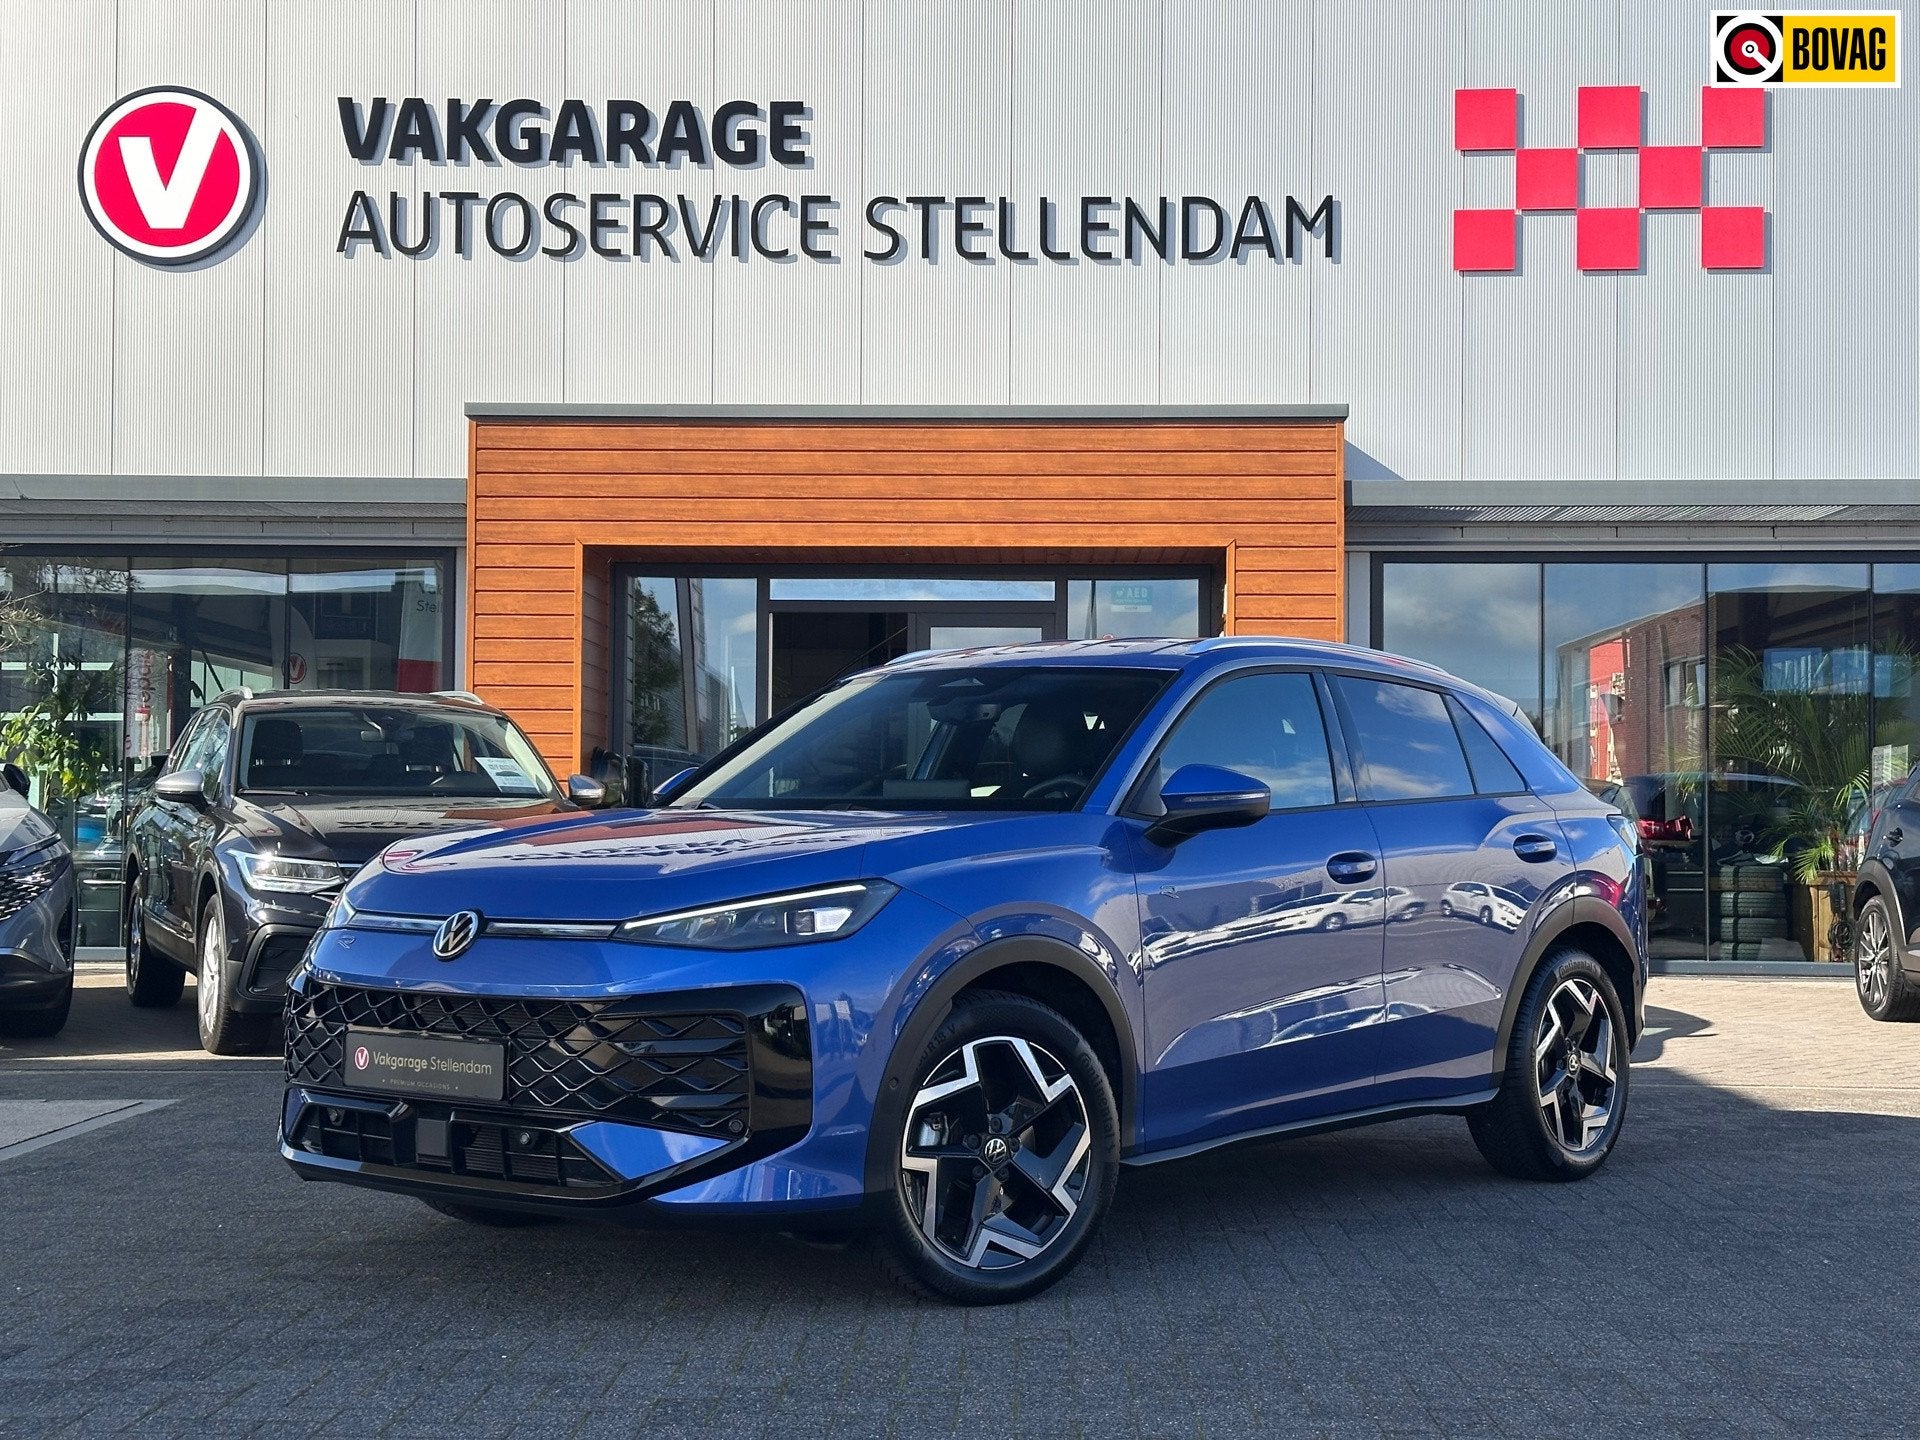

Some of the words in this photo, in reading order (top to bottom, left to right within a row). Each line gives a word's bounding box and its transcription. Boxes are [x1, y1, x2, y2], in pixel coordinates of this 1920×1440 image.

[337, 97, 806, 165] VAKGARAGE
[336, 190, 832, 259] AUTOSERVICE
[863, 195, 1334, 261] STELLENDAM
[372, 1051, 428, 1072] Vakgarage
[430, 1056, 492, 1075] Stellendam
